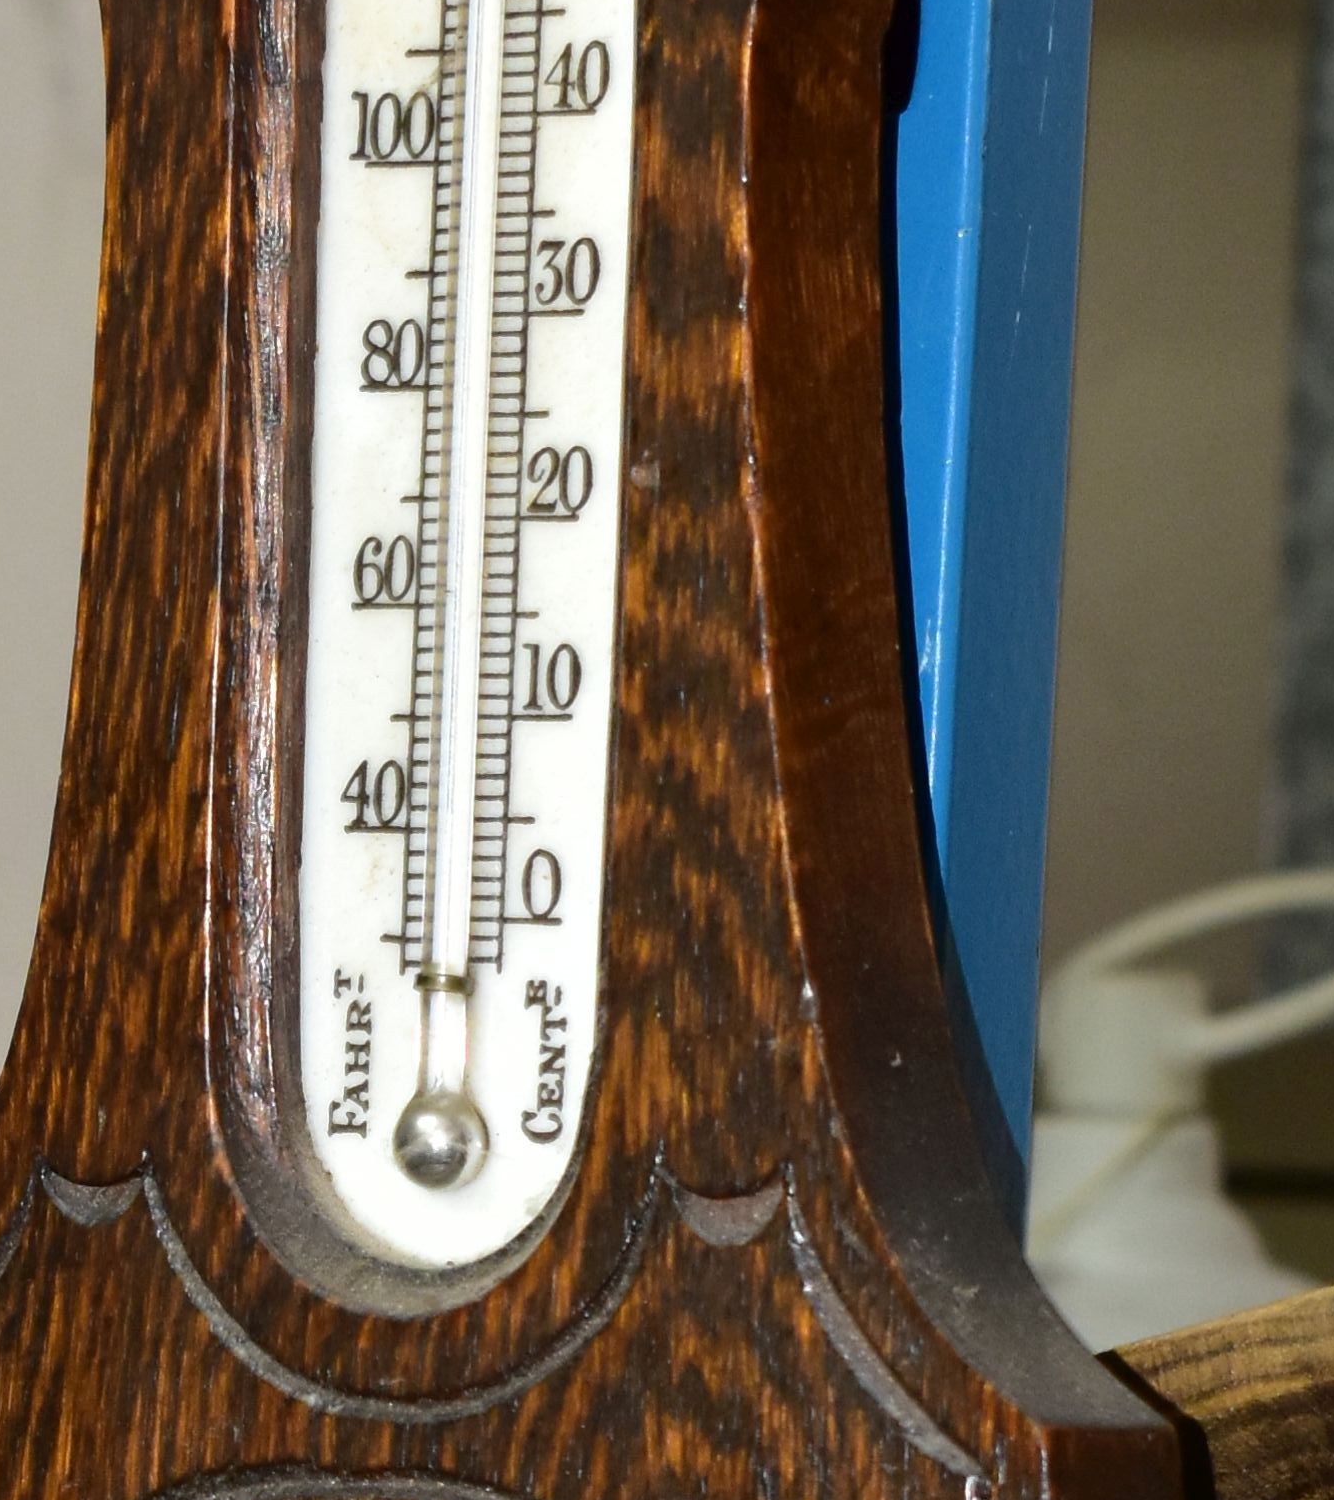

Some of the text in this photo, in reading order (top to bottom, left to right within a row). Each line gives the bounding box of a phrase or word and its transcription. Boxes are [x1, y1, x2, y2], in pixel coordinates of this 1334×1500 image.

[545, 40, 611, 110] 40
[350, 92, 438, 162] 100
[534, 236, 601, 306] 30
[360, 318, 426, 386] 80
[526, 446, 593, 514] 20
[352, 534, 416, 604] 60
[522, 642, 583, 713] 10
[340, 759, 407, 829] 40
[522, 848, 563, 919] 0
